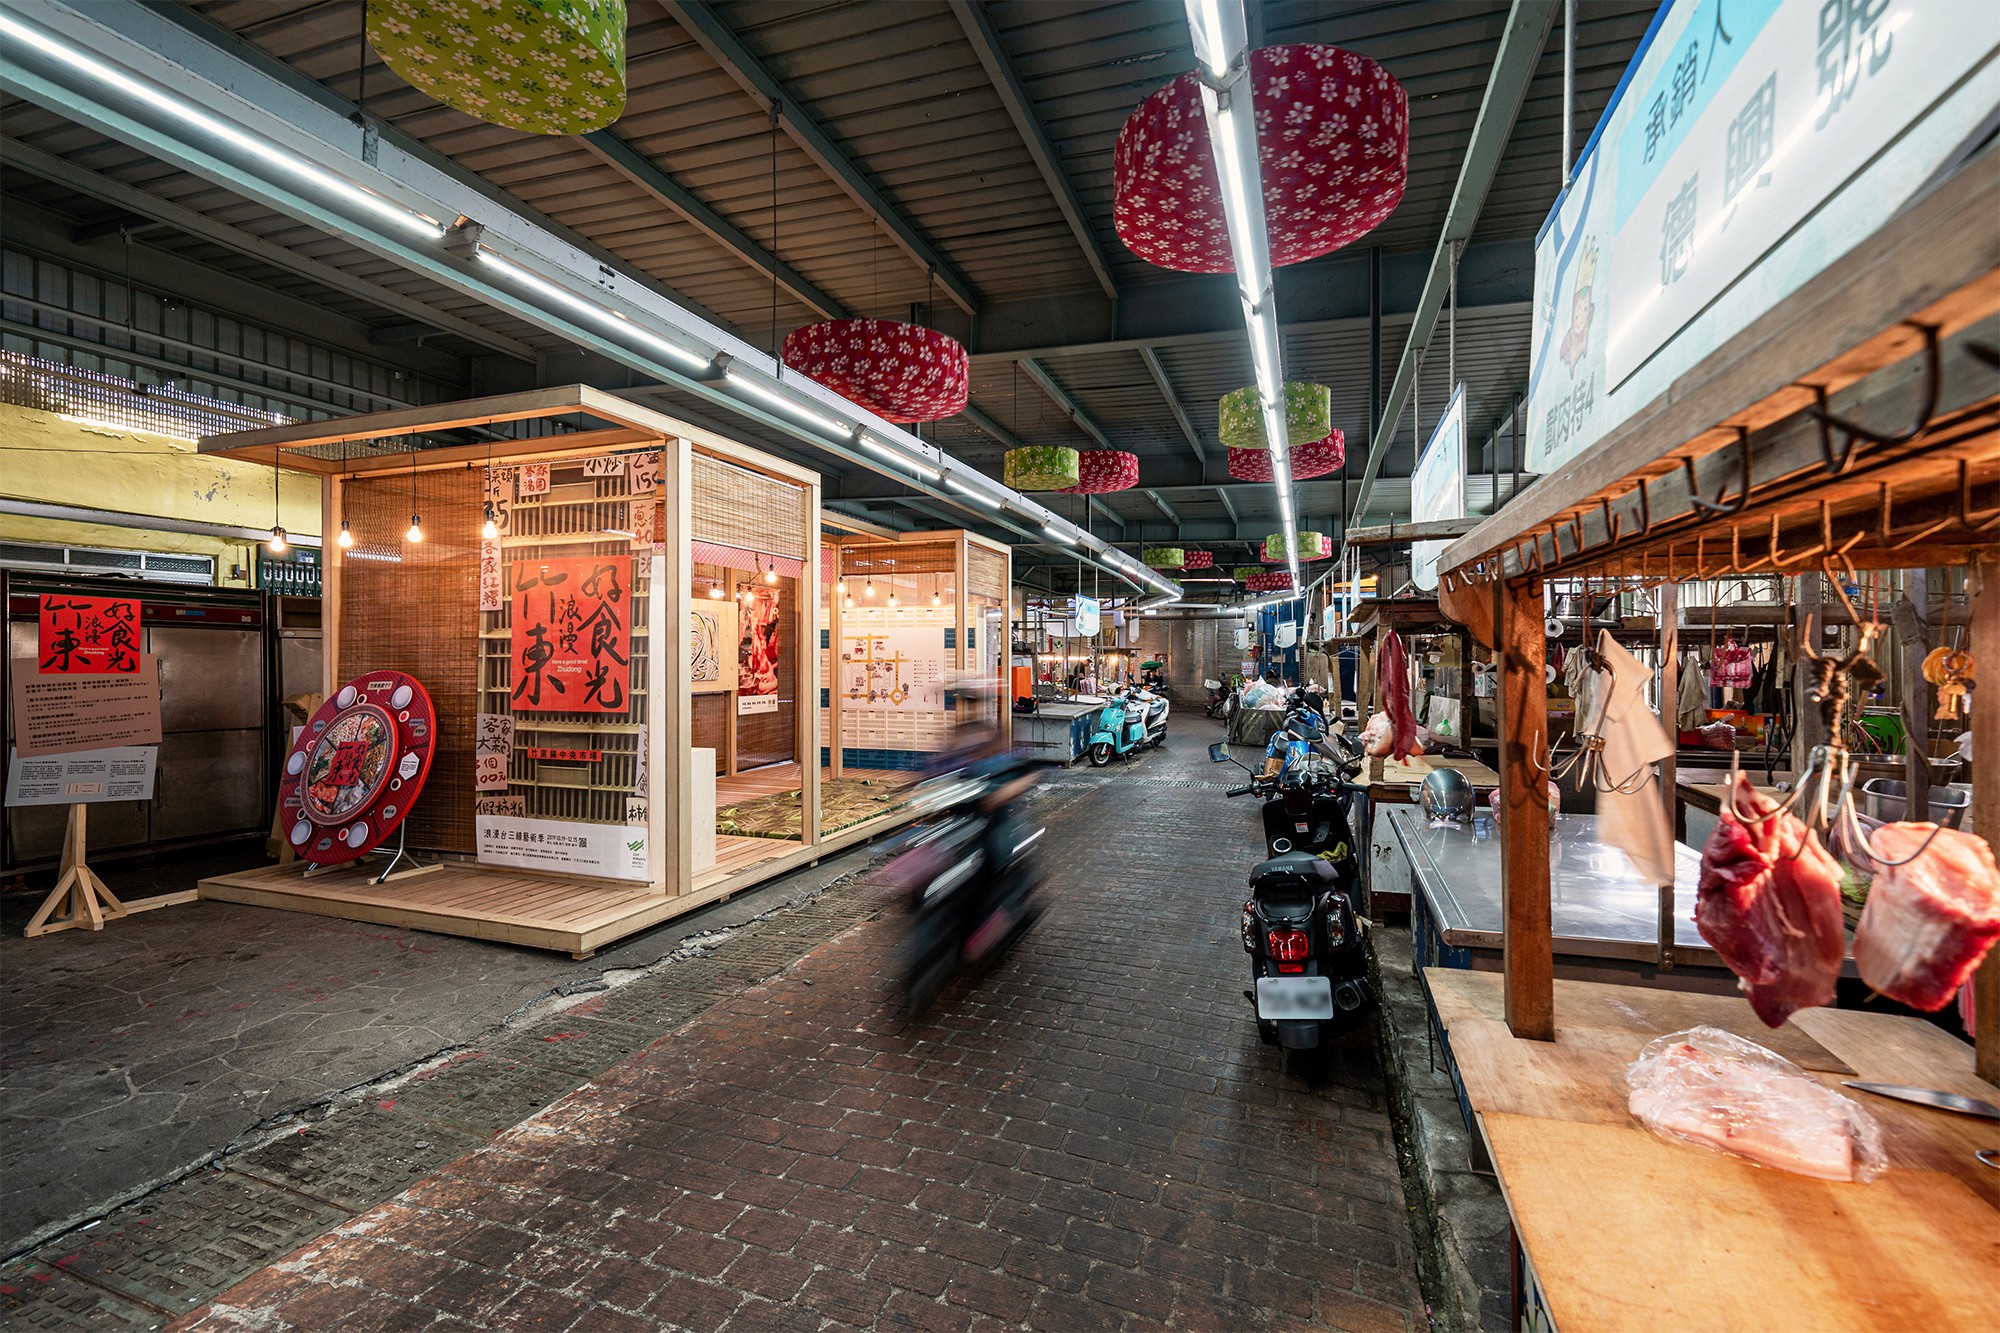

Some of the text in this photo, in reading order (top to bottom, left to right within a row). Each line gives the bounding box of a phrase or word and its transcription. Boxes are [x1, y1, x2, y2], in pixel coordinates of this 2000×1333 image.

[1642, 0, 1732, 165] 承銷人
[584, 458, 620, 474] 小炒
[84, 615, 104, 647] 浪漫
[100, 601, 140, 672] 好食光
[559, 593, 582, 655] 浪漫
[577, 564, 630, 709] 好食光
[483, 716, 512, 736] 客家
[530, 749, 598, 761] 竹東鎮中央市場
[483, 828, 545, 844] 浪漫台三線藝術季
